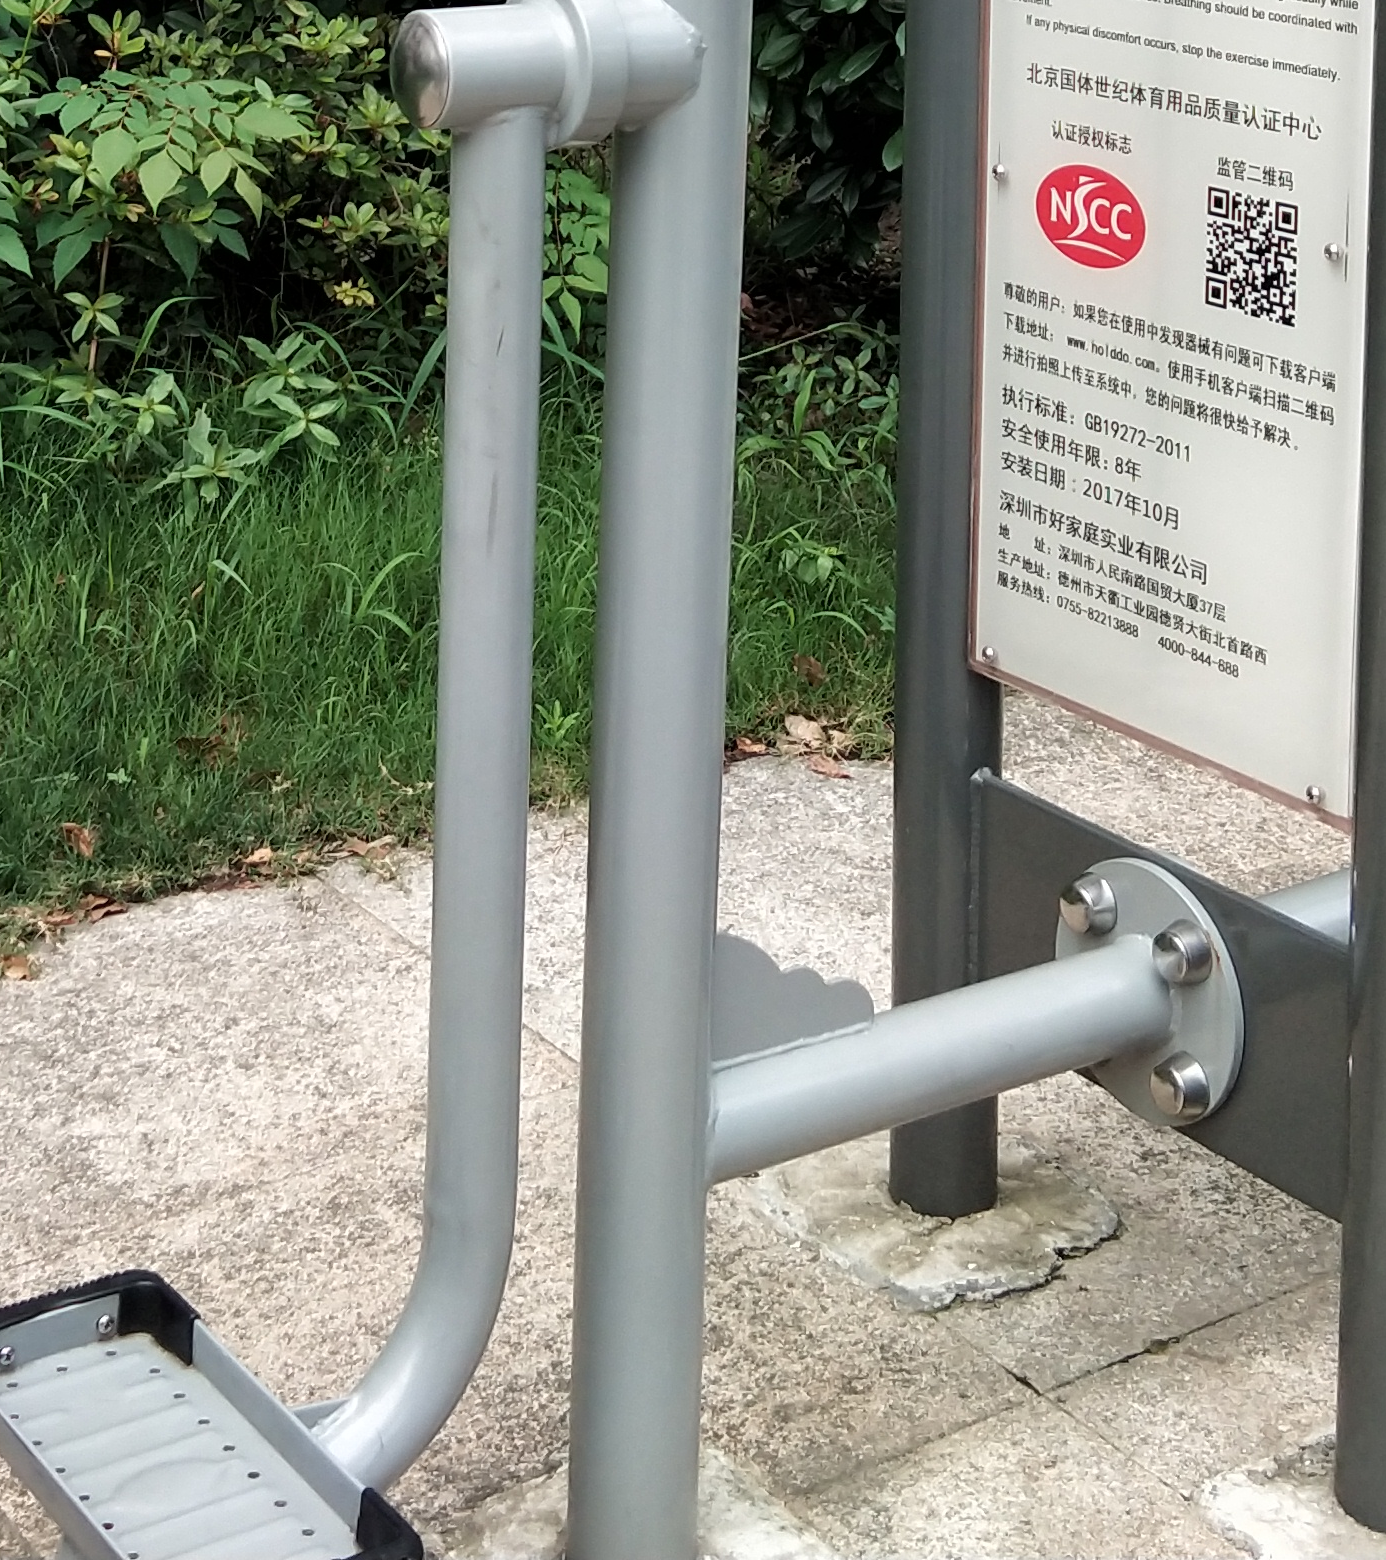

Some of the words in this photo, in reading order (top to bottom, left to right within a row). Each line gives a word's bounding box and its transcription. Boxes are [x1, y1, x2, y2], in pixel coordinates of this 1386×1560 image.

[1034, 17, 1051, 31] any
[1053, 20, 1090, 36] physical
[1092, 26, 1141, 45] discomfort
[1182, 43, 1203, 58] stop
[1206, 47, 1222, 59] the
[1225, 52, 1269, 68] exercise
[1214, 1, 1249, 17] should
[1252, 7, 1265, 19] be
[1268, 11, 1332, 30] coordinated
[1335, 21, 1358, 35] with
[1027, 62, 1322, 140] 北京国体世纪体育用品质量认证中心
[1052, 120, 1132, 154] 认证授权标志
[1217, 157, 1293, 190] 监管二维码
[1050, 176, 1131, 240] NSCC
[999, 490, 1207, 585] 深圳市好家庭实业有限公司
